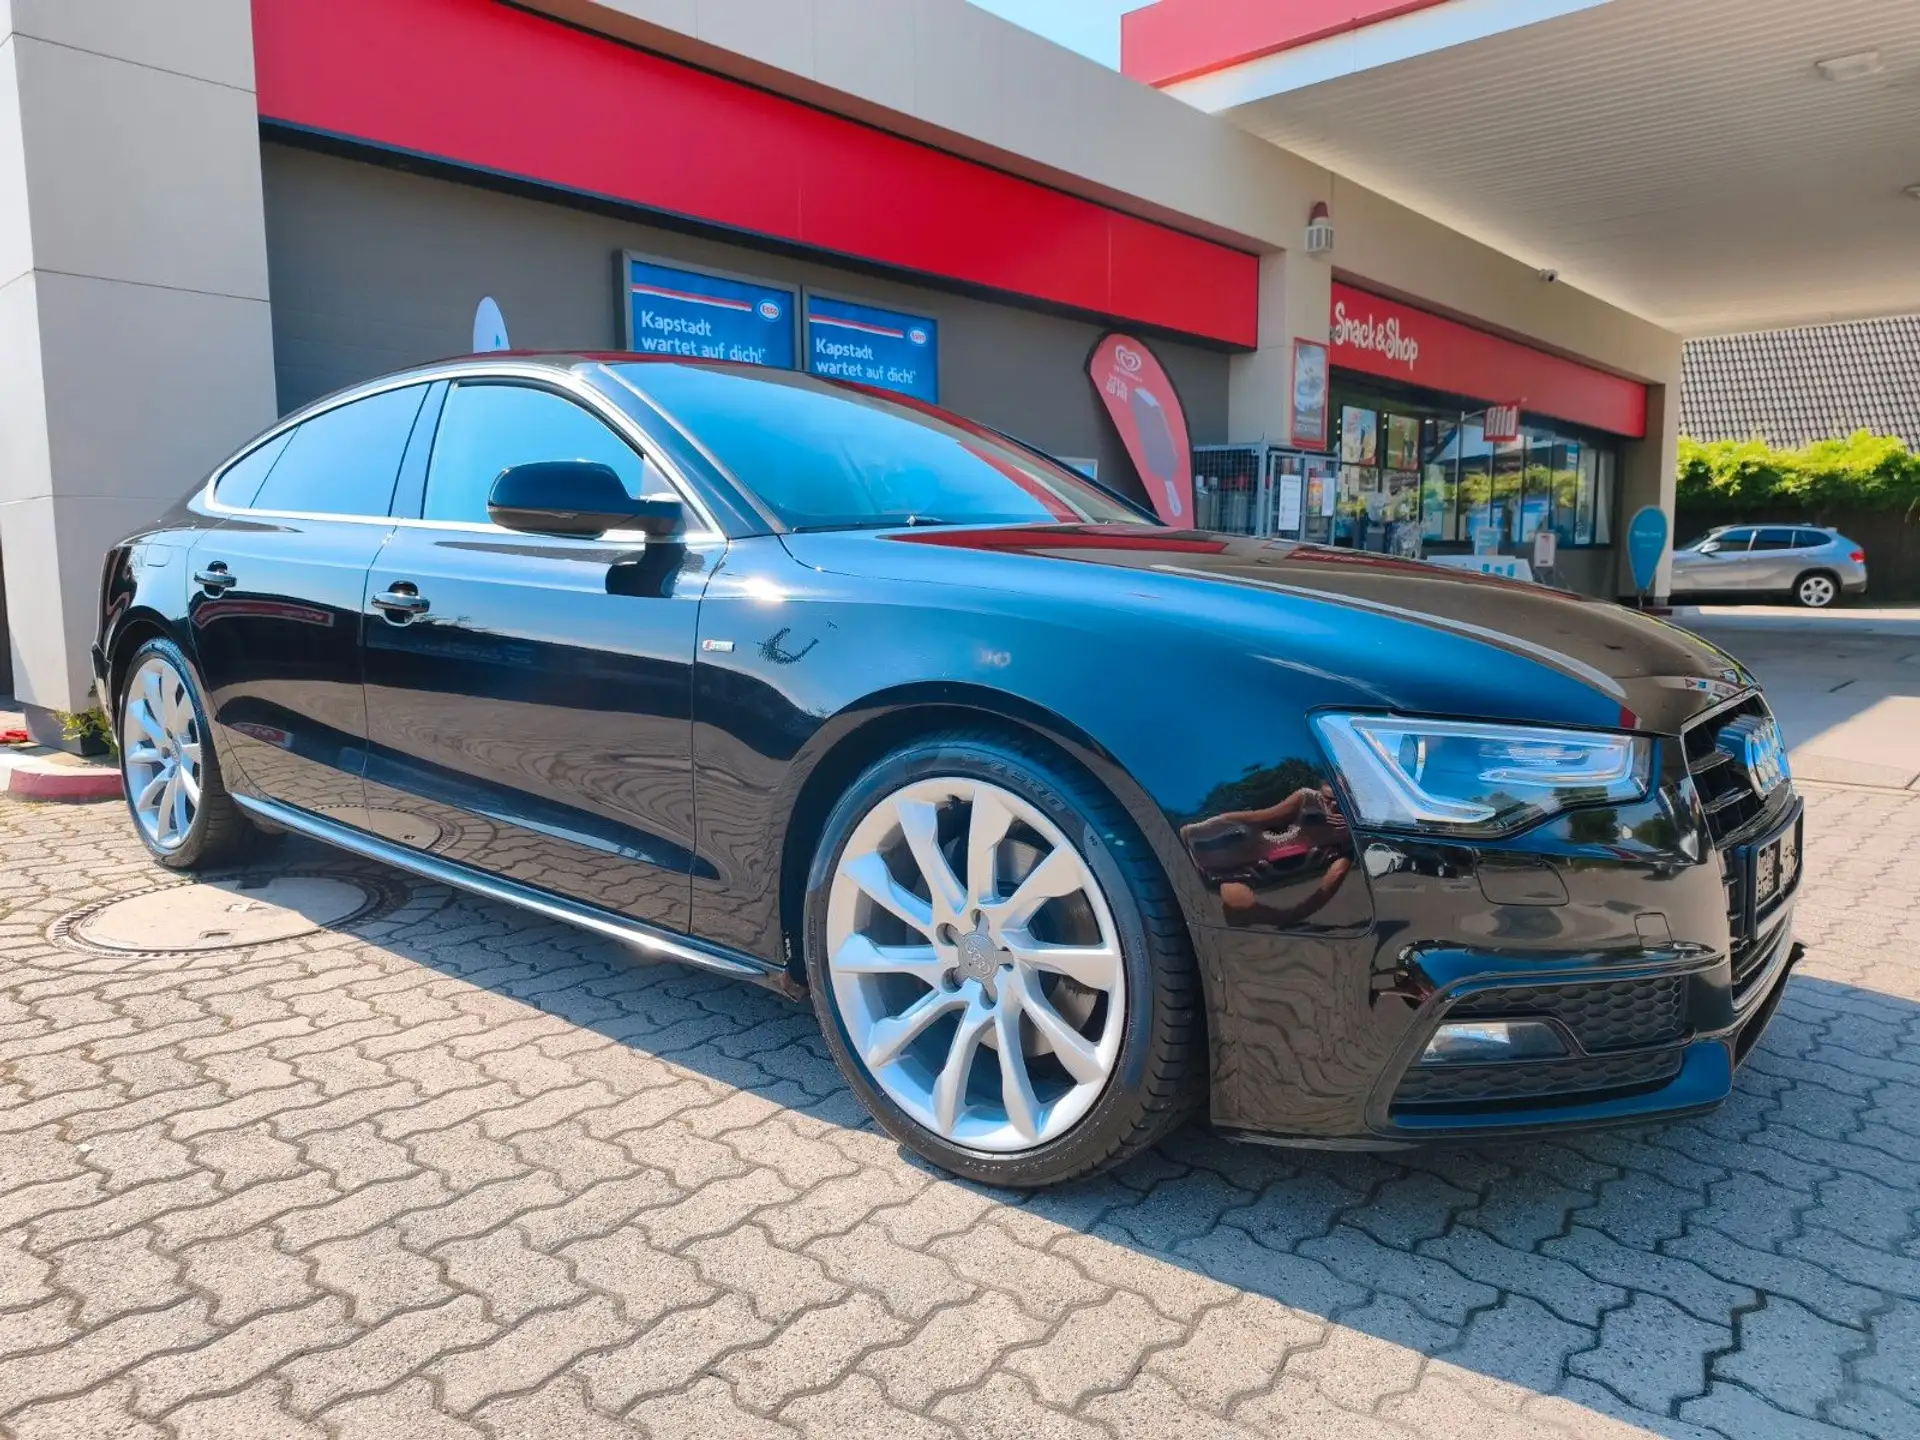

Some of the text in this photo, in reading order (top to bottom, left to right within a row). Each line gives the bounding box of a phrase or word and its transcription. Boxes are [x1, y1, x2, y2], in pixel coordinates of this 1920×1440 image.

[641, 310, 712, 337] Kapstadt
[641, 337, 697, 356] wartet
[701, 342, 725, 359] auf
[816, 337, 873, 360] Kapstadt
[816, 361, 862, 377] wartet
[866, 366, 884, 380] auf
